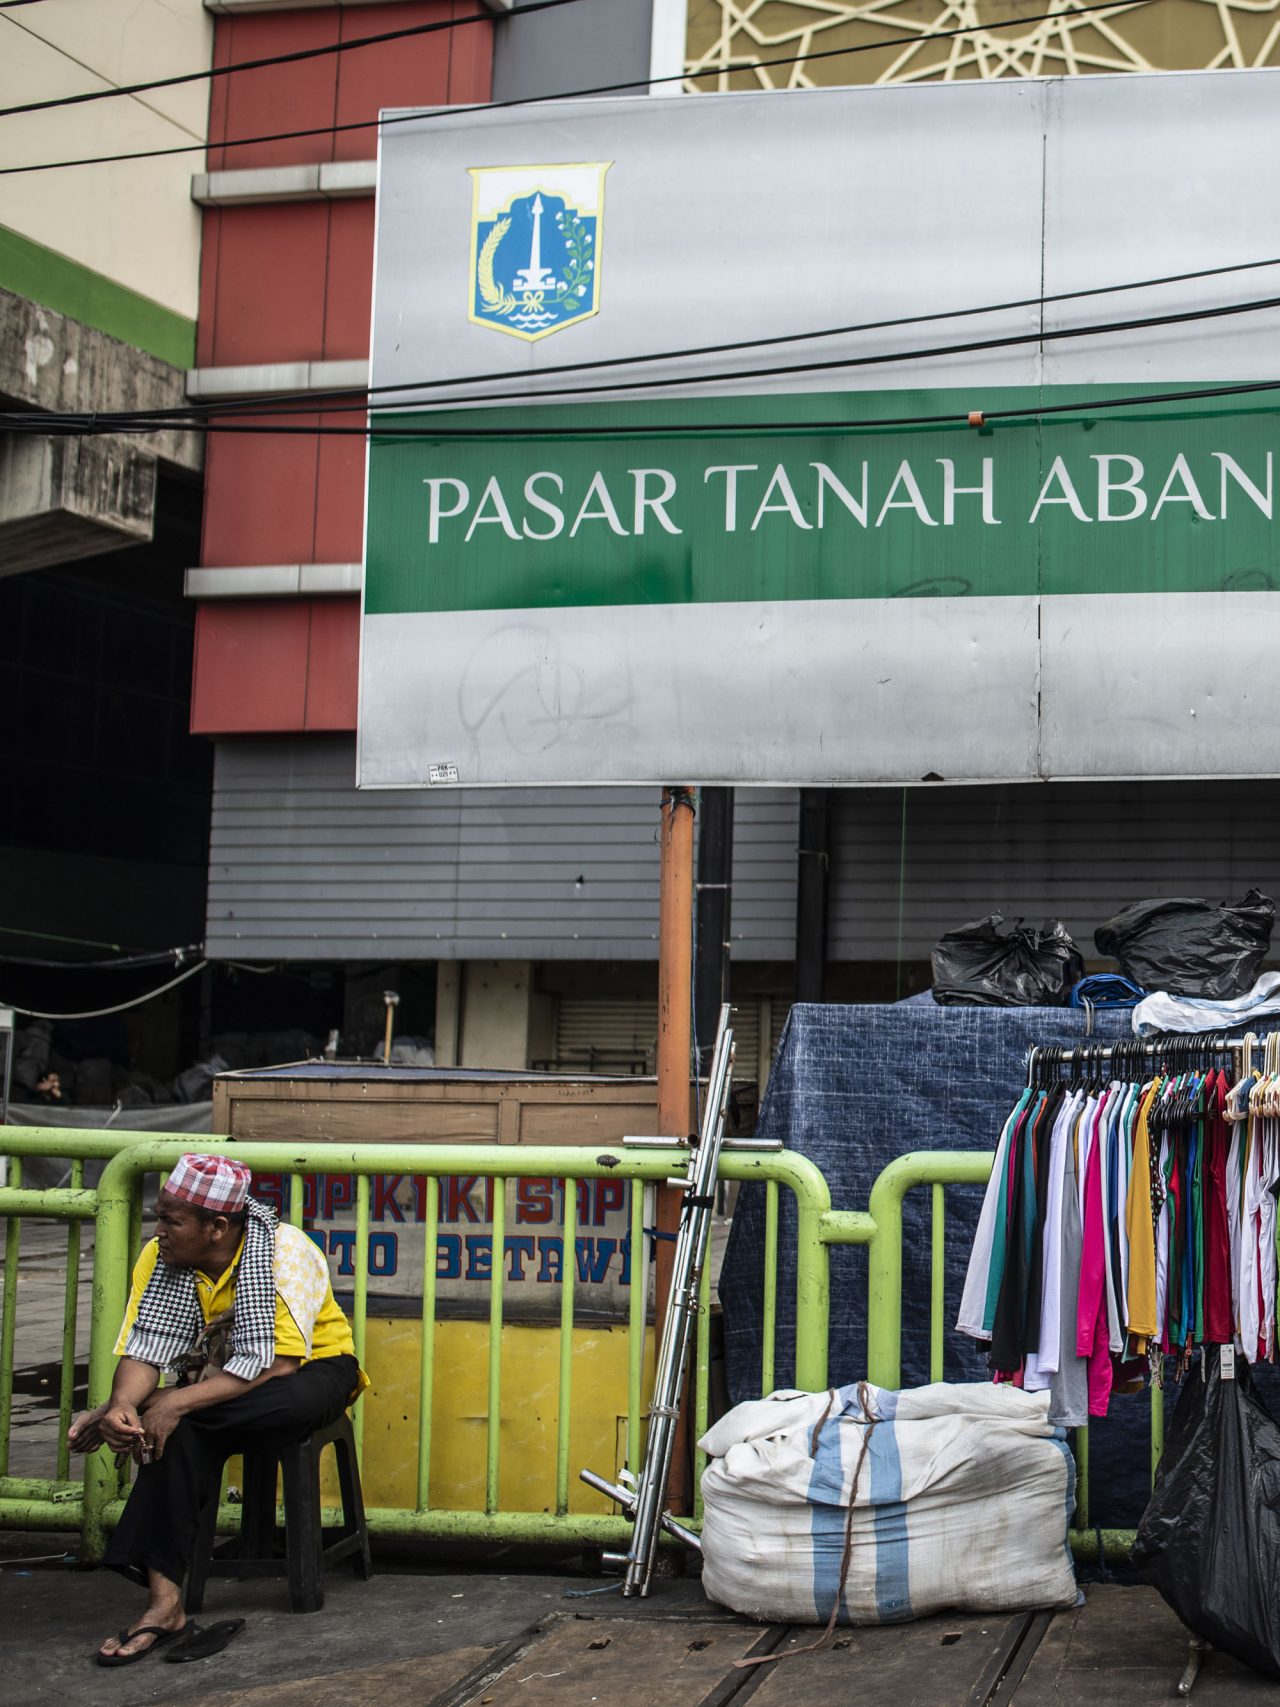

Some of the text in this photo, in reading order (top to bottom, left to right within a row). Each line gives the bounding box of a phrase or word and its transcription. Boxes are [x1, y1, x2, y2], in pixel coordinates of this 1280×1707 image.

[422, 468, 683, 544] PASAR
[704, 457, 1002, 533] TANAH
[250, 1174, 353, 1220] SOP
[516, 1176, 633, 1227] SAP
